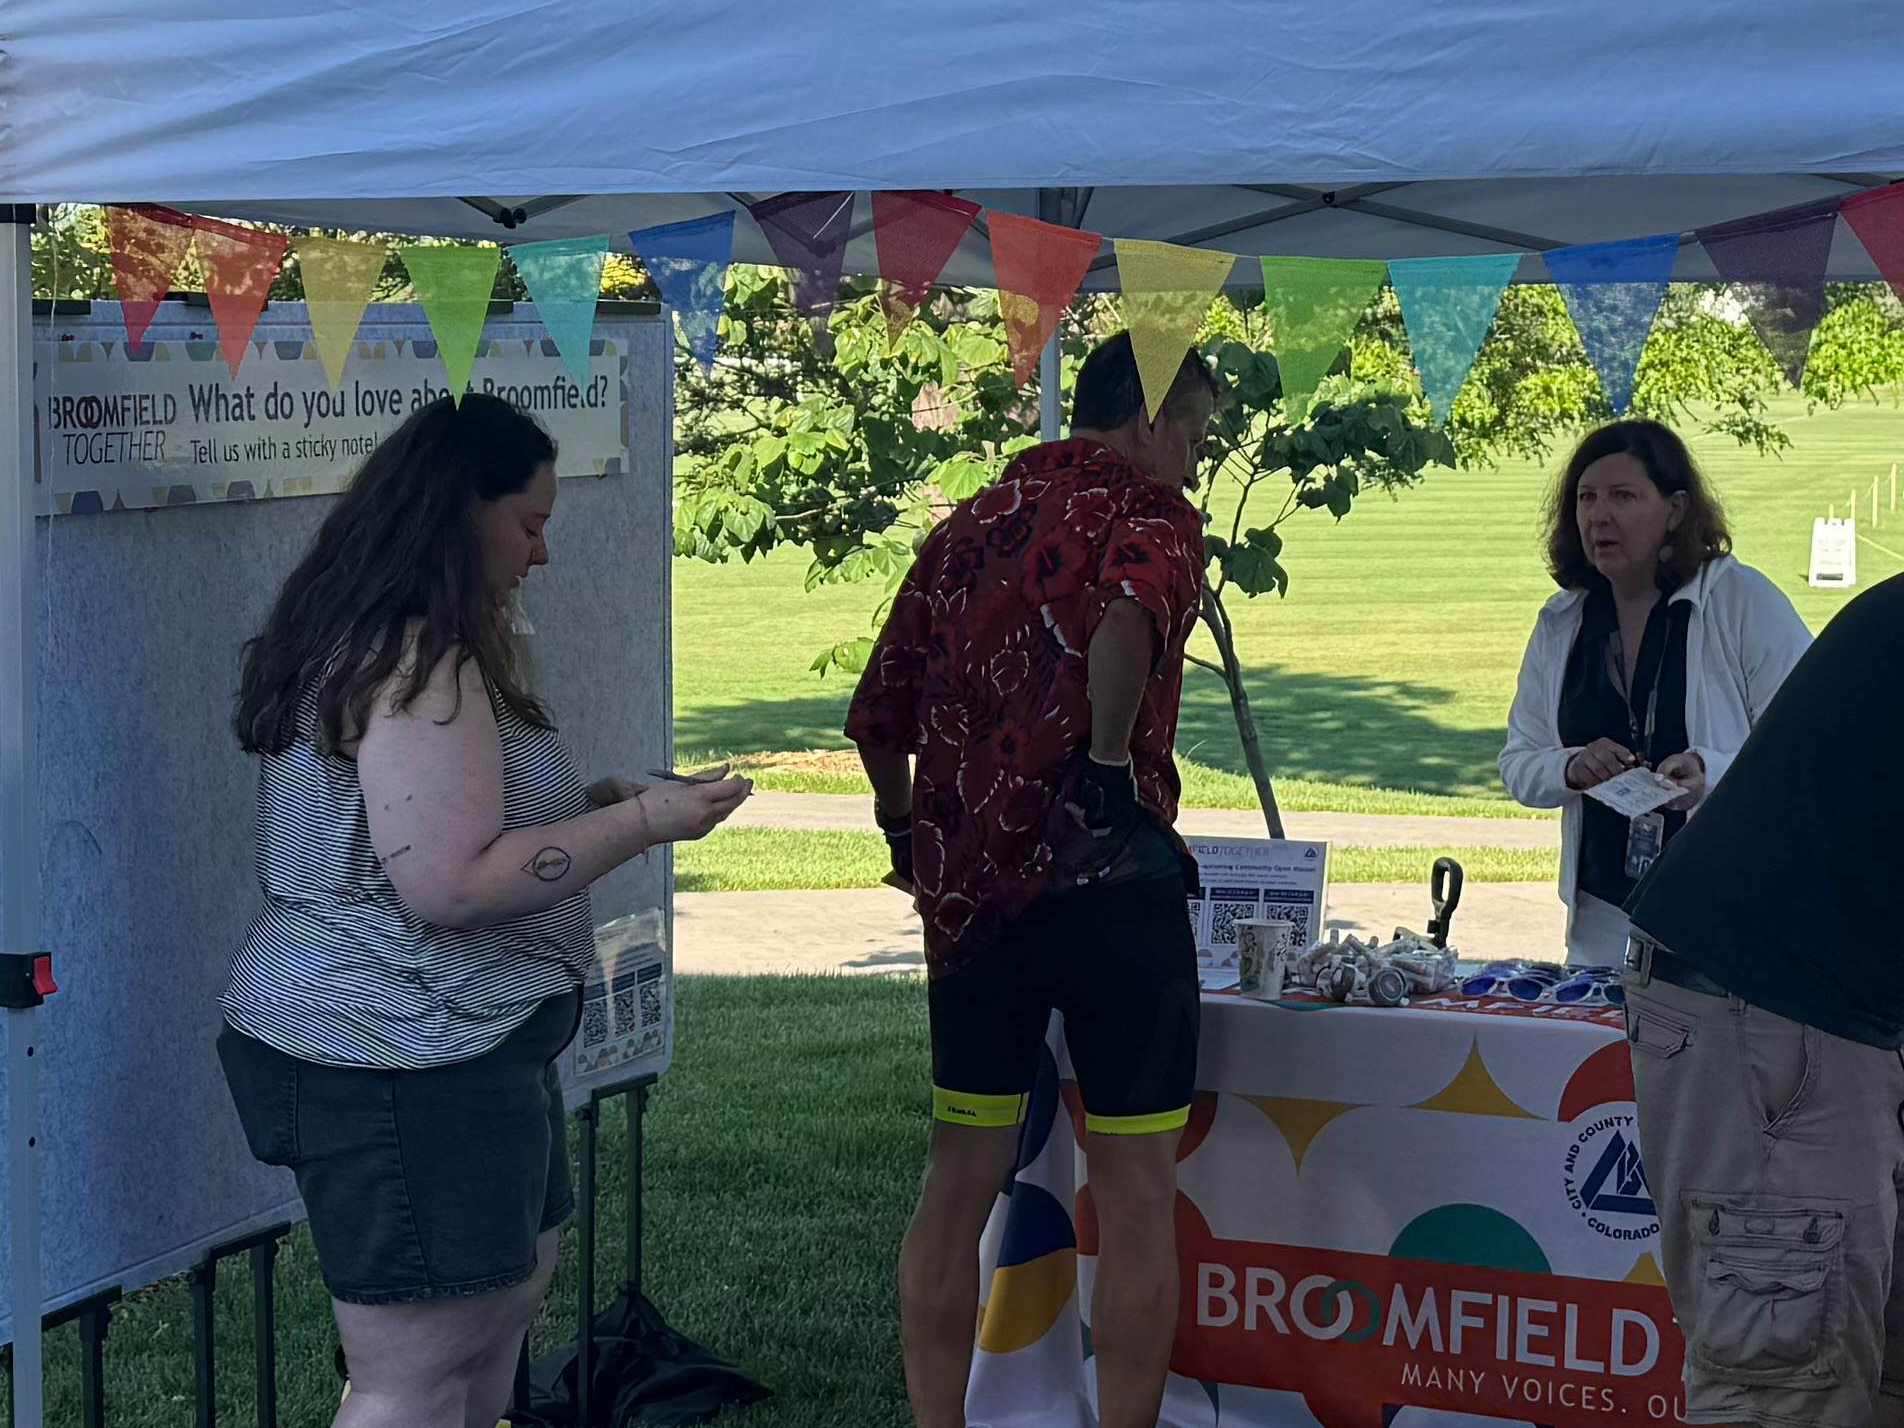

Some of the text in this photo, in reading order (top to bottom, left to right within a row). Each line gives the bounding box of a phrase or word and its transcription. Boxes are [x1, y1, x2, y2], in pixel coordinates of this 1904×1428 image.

[48, 393, 177, 429] BROOMFIELD
[188, 382, 255, 422] What
[264, 381, 293, 420] do
[301, 390, 344, 427] you
[355, 378, 402, 417] love
[63, 430, 166, 465] TOGETHER
[190, 438, 217, 464] Tell
[223, 444, 239, 462] us
[243, 435, 276, 461] with
[282, 441, 290, 459] a
[295, 434, 336, 460] sticky
[1564, 1116, 1634, 1209] CITY AND COUNTY
[1587, 1217, 1660, 1240] COLORADO
[1401, 1363, 1686, 1420] MANY VOICES. OU
